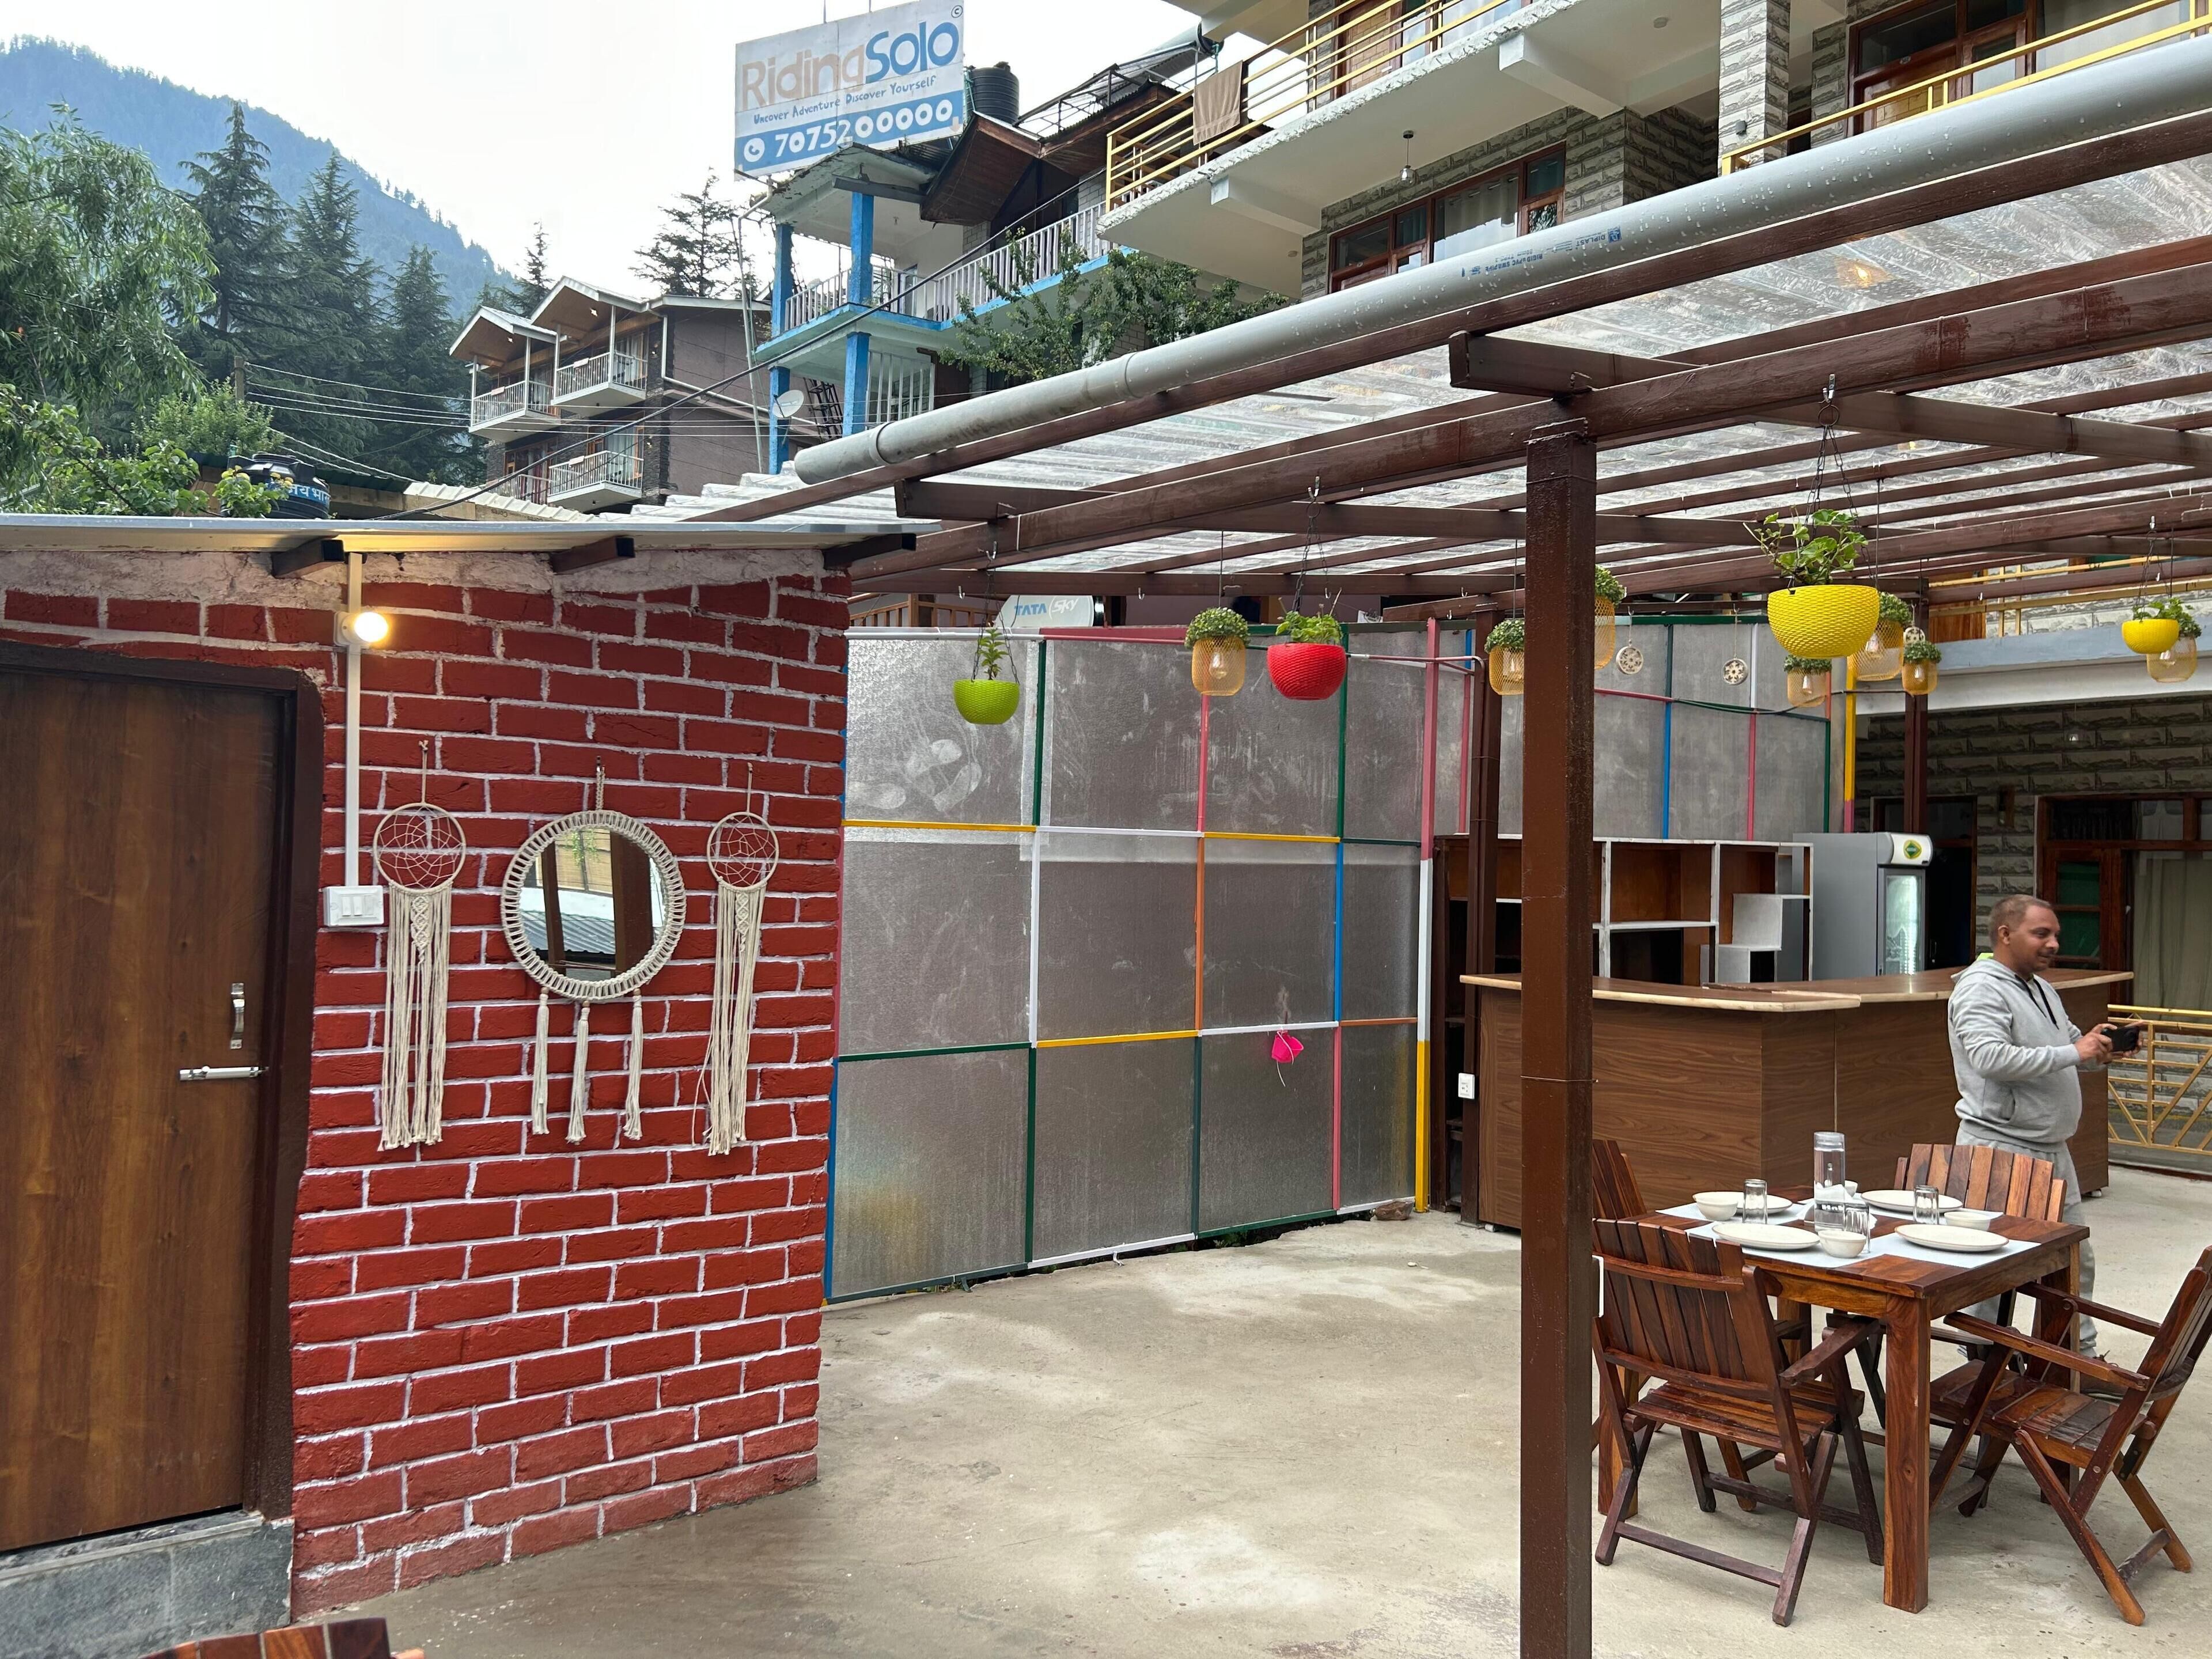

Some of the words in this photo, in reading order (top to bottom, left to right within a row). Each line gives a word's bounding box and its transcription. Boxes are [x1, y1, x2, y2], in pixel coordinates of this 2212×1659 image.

[742, 21, 960, 111] RidingSolo
[754, 111, 789, 124] Uncover
[792, 99, 840, 118] Adventure
[846, 89, 887, 104] Discover
[890, 75, 937, 95] Yourself
[775, 100, 953, 157] 7075200000
[1575, 234, 1606, 247] DIPLAST
[1014, 603, 1047, 616] TATA
